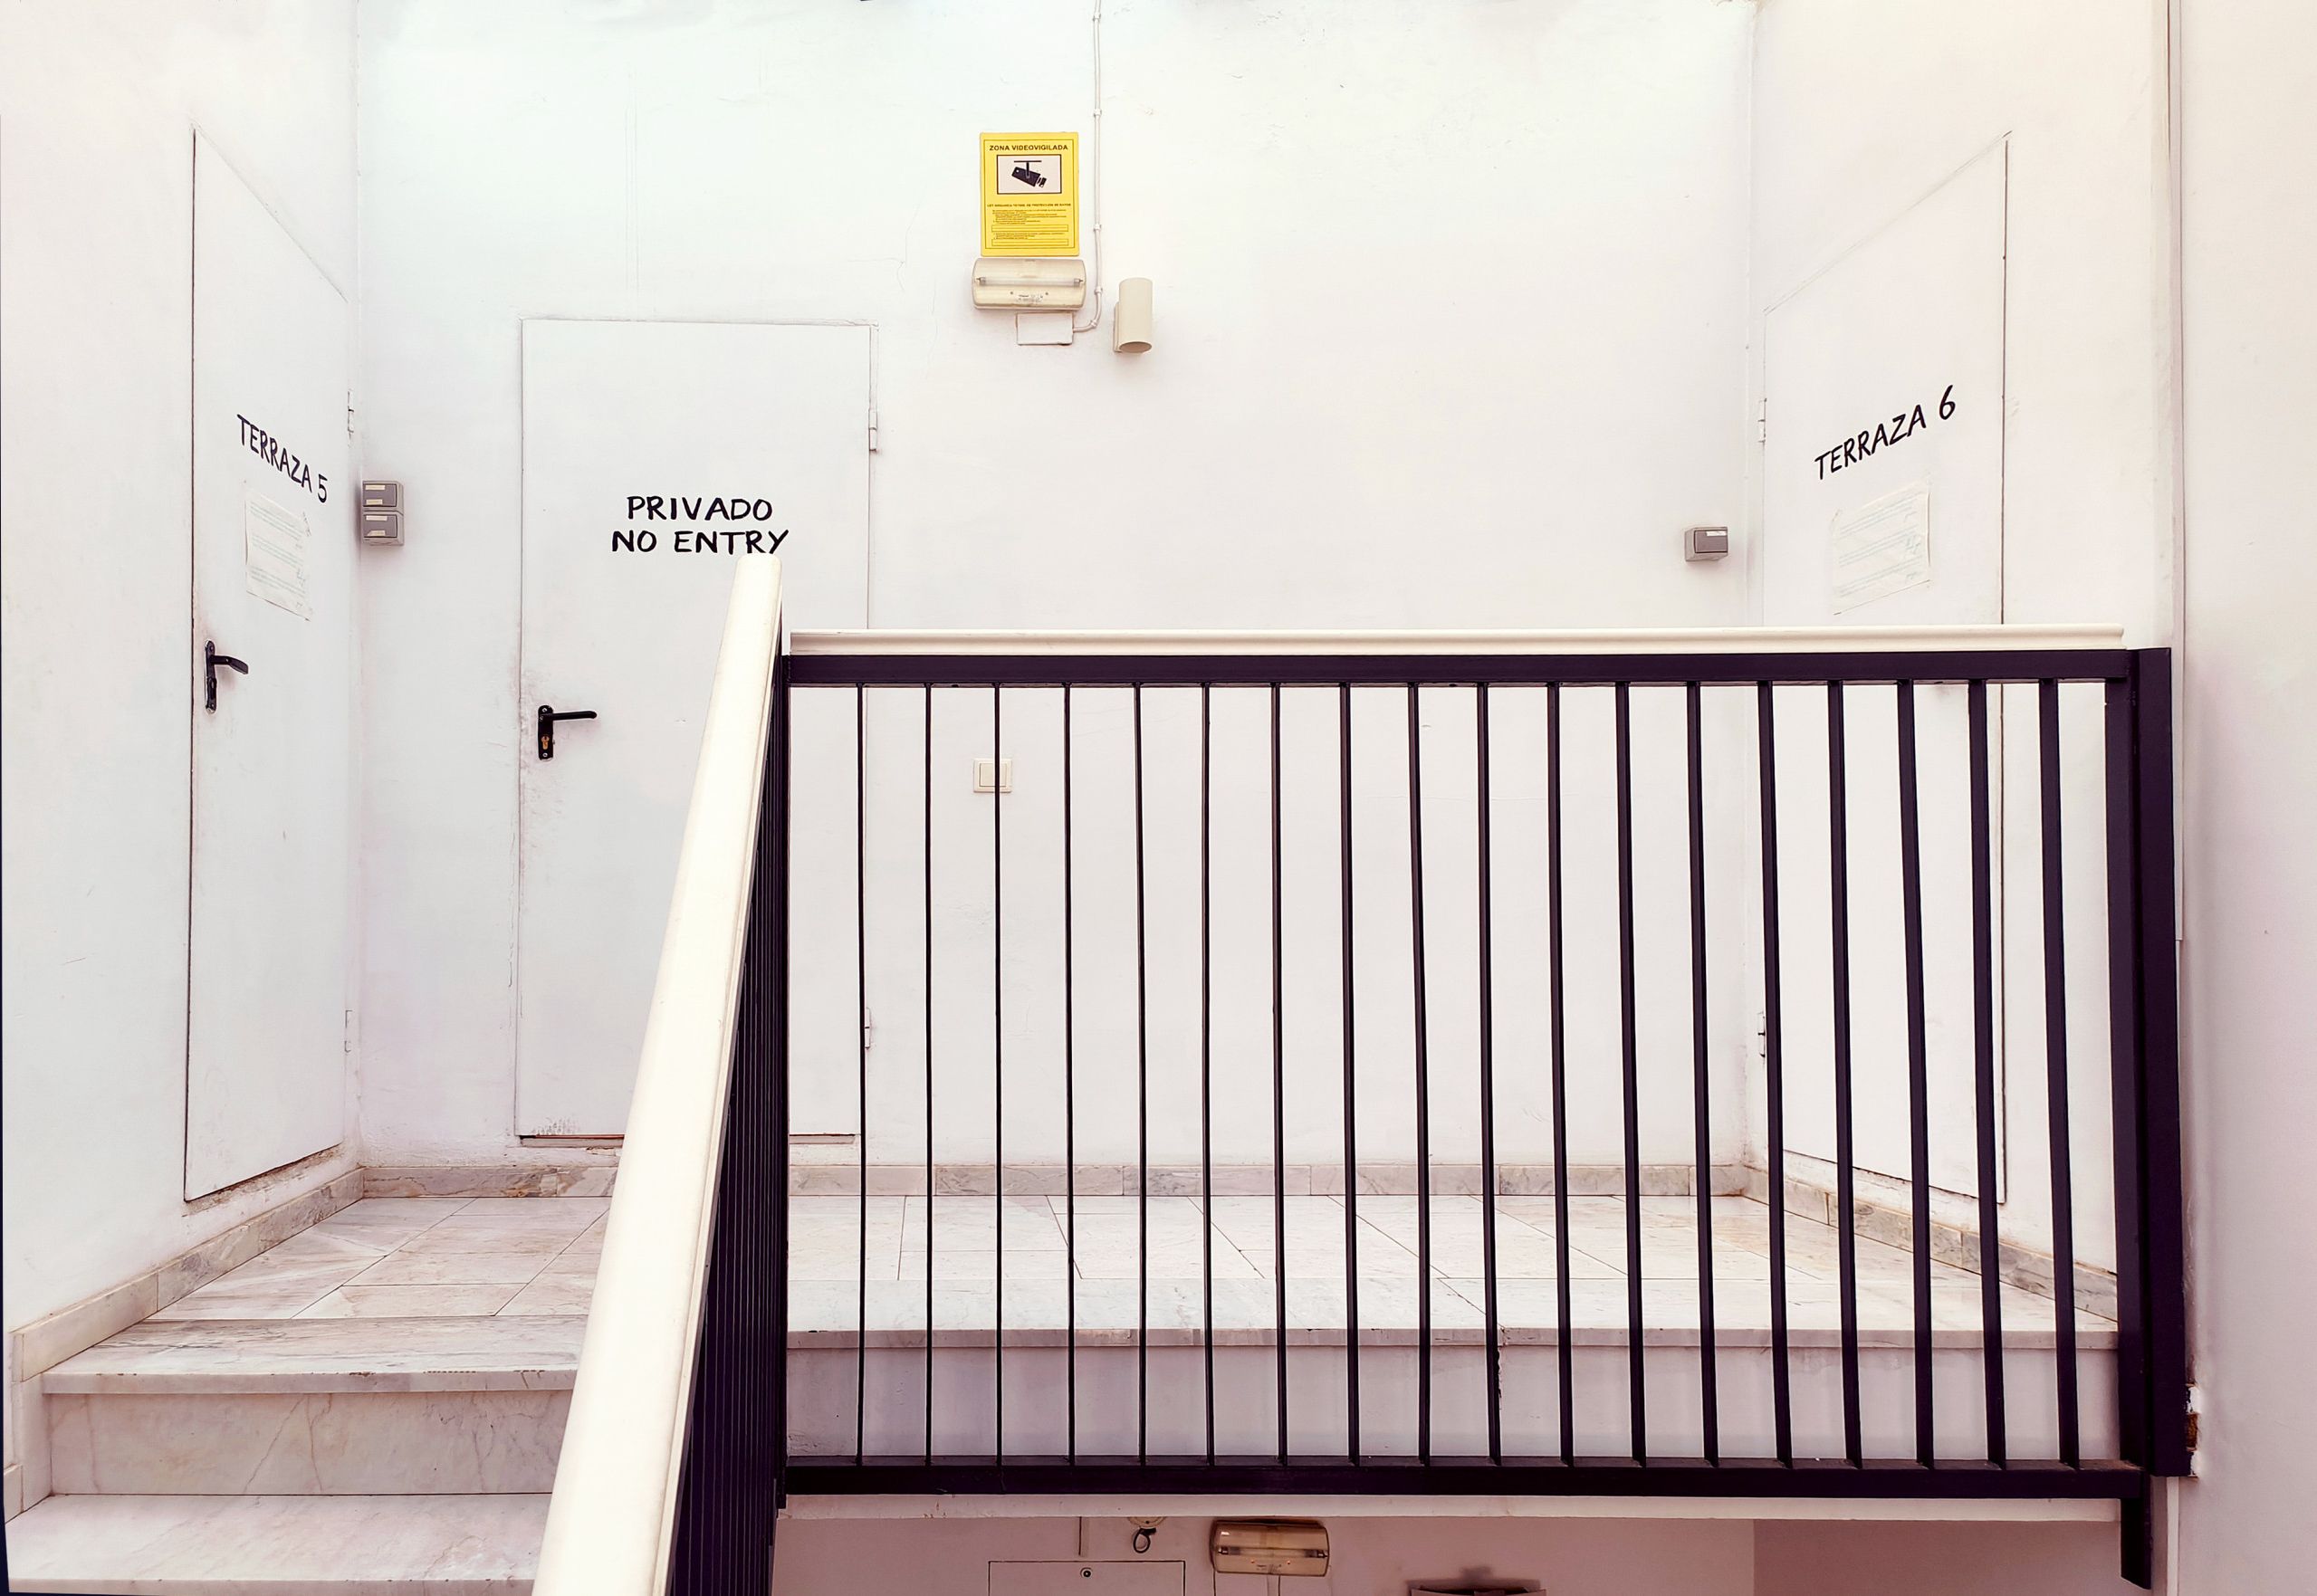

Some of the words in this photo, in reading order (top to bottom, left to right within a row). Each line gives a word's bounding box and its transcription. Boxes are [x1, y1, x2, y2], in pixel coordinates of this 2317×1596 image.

[236, 414, 312, 493] TERRAZA
[317, 473, 328, 503] 5
[1814, 404, 1927, 481] TERRAZA
[1939, 384, 1956, 421] 6
[627, 495, 773, 521] PRIVADO
[611, 530, 657, 553] NO
[674, 529, 790, 556] ENTRY
